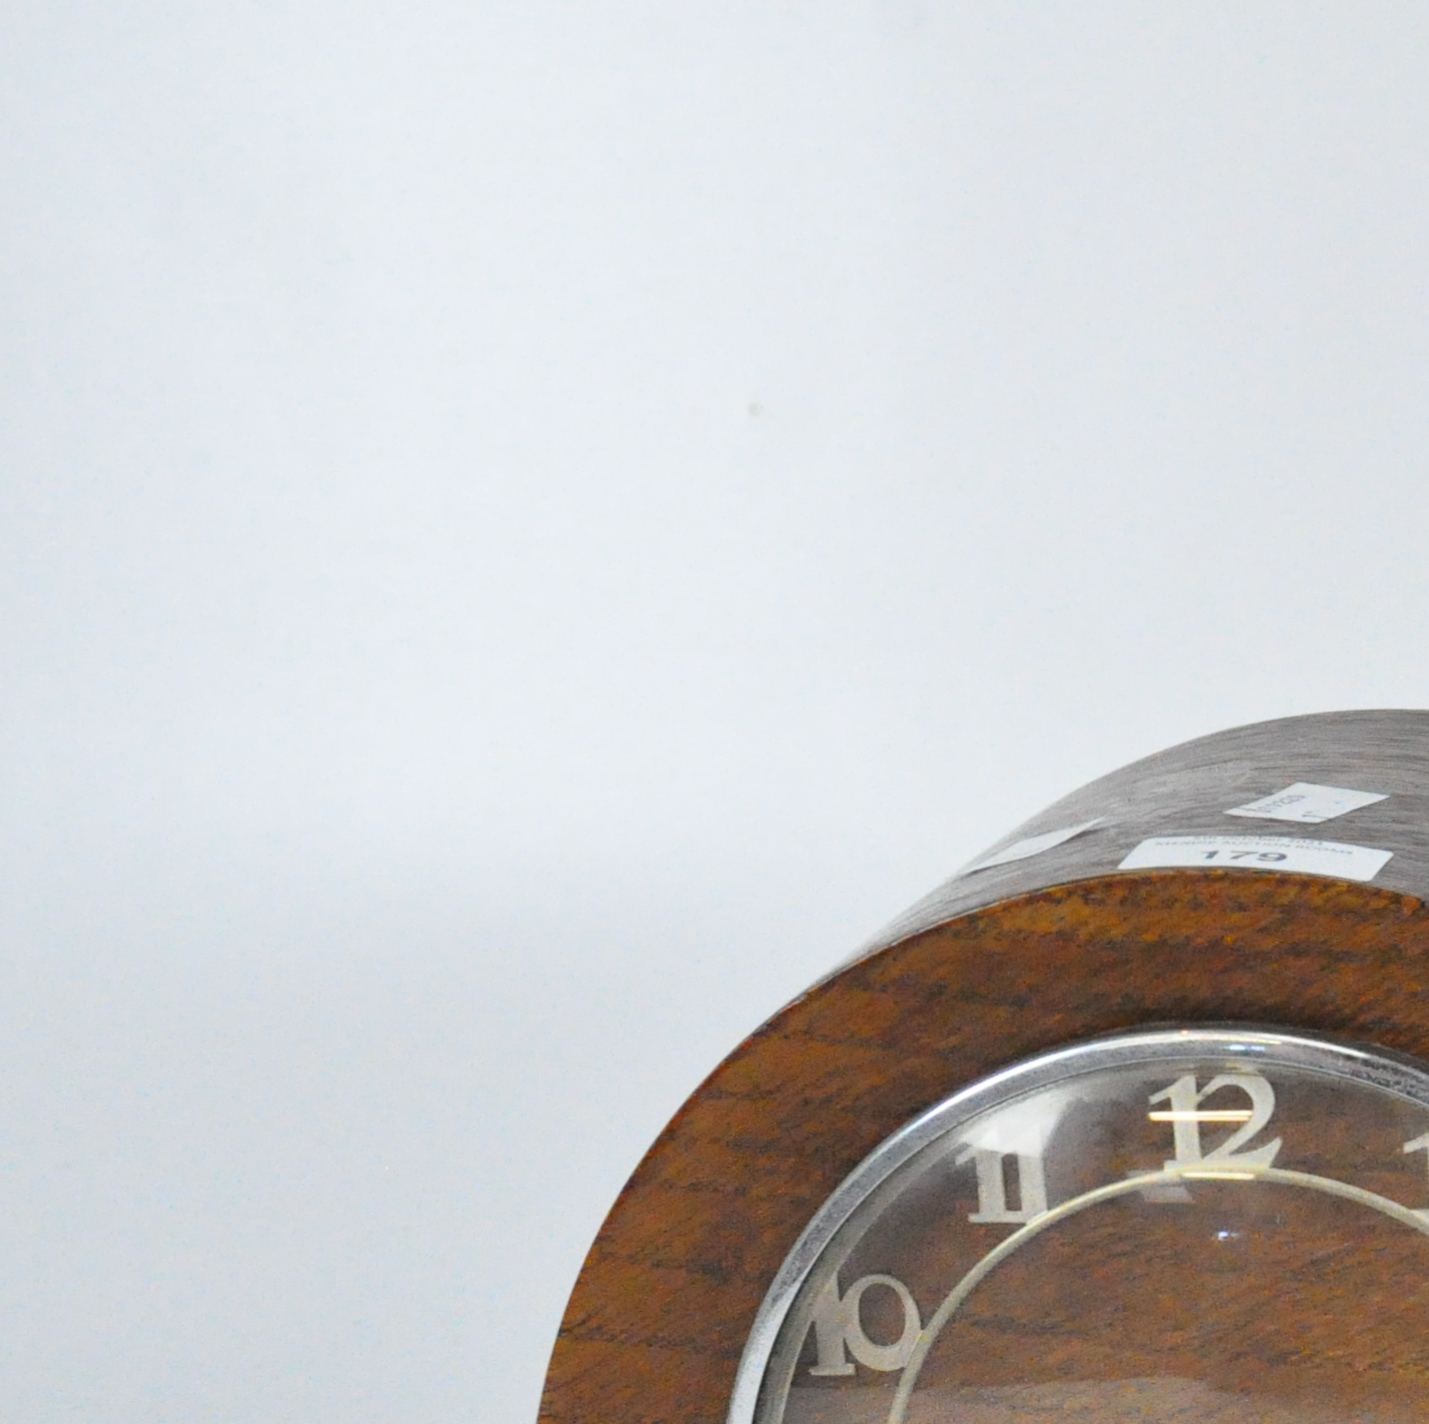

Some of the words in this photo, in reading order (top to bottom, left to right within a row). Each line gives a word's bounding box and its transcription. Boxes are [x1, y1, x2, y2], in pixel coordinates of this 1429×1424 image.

[1201, 849, 1288, 862] 179
[1149, 1074, 1283, 1170] 12
[955, 1124, 1048, 1224] 11
[809, 1271, 922, 1376] 10
